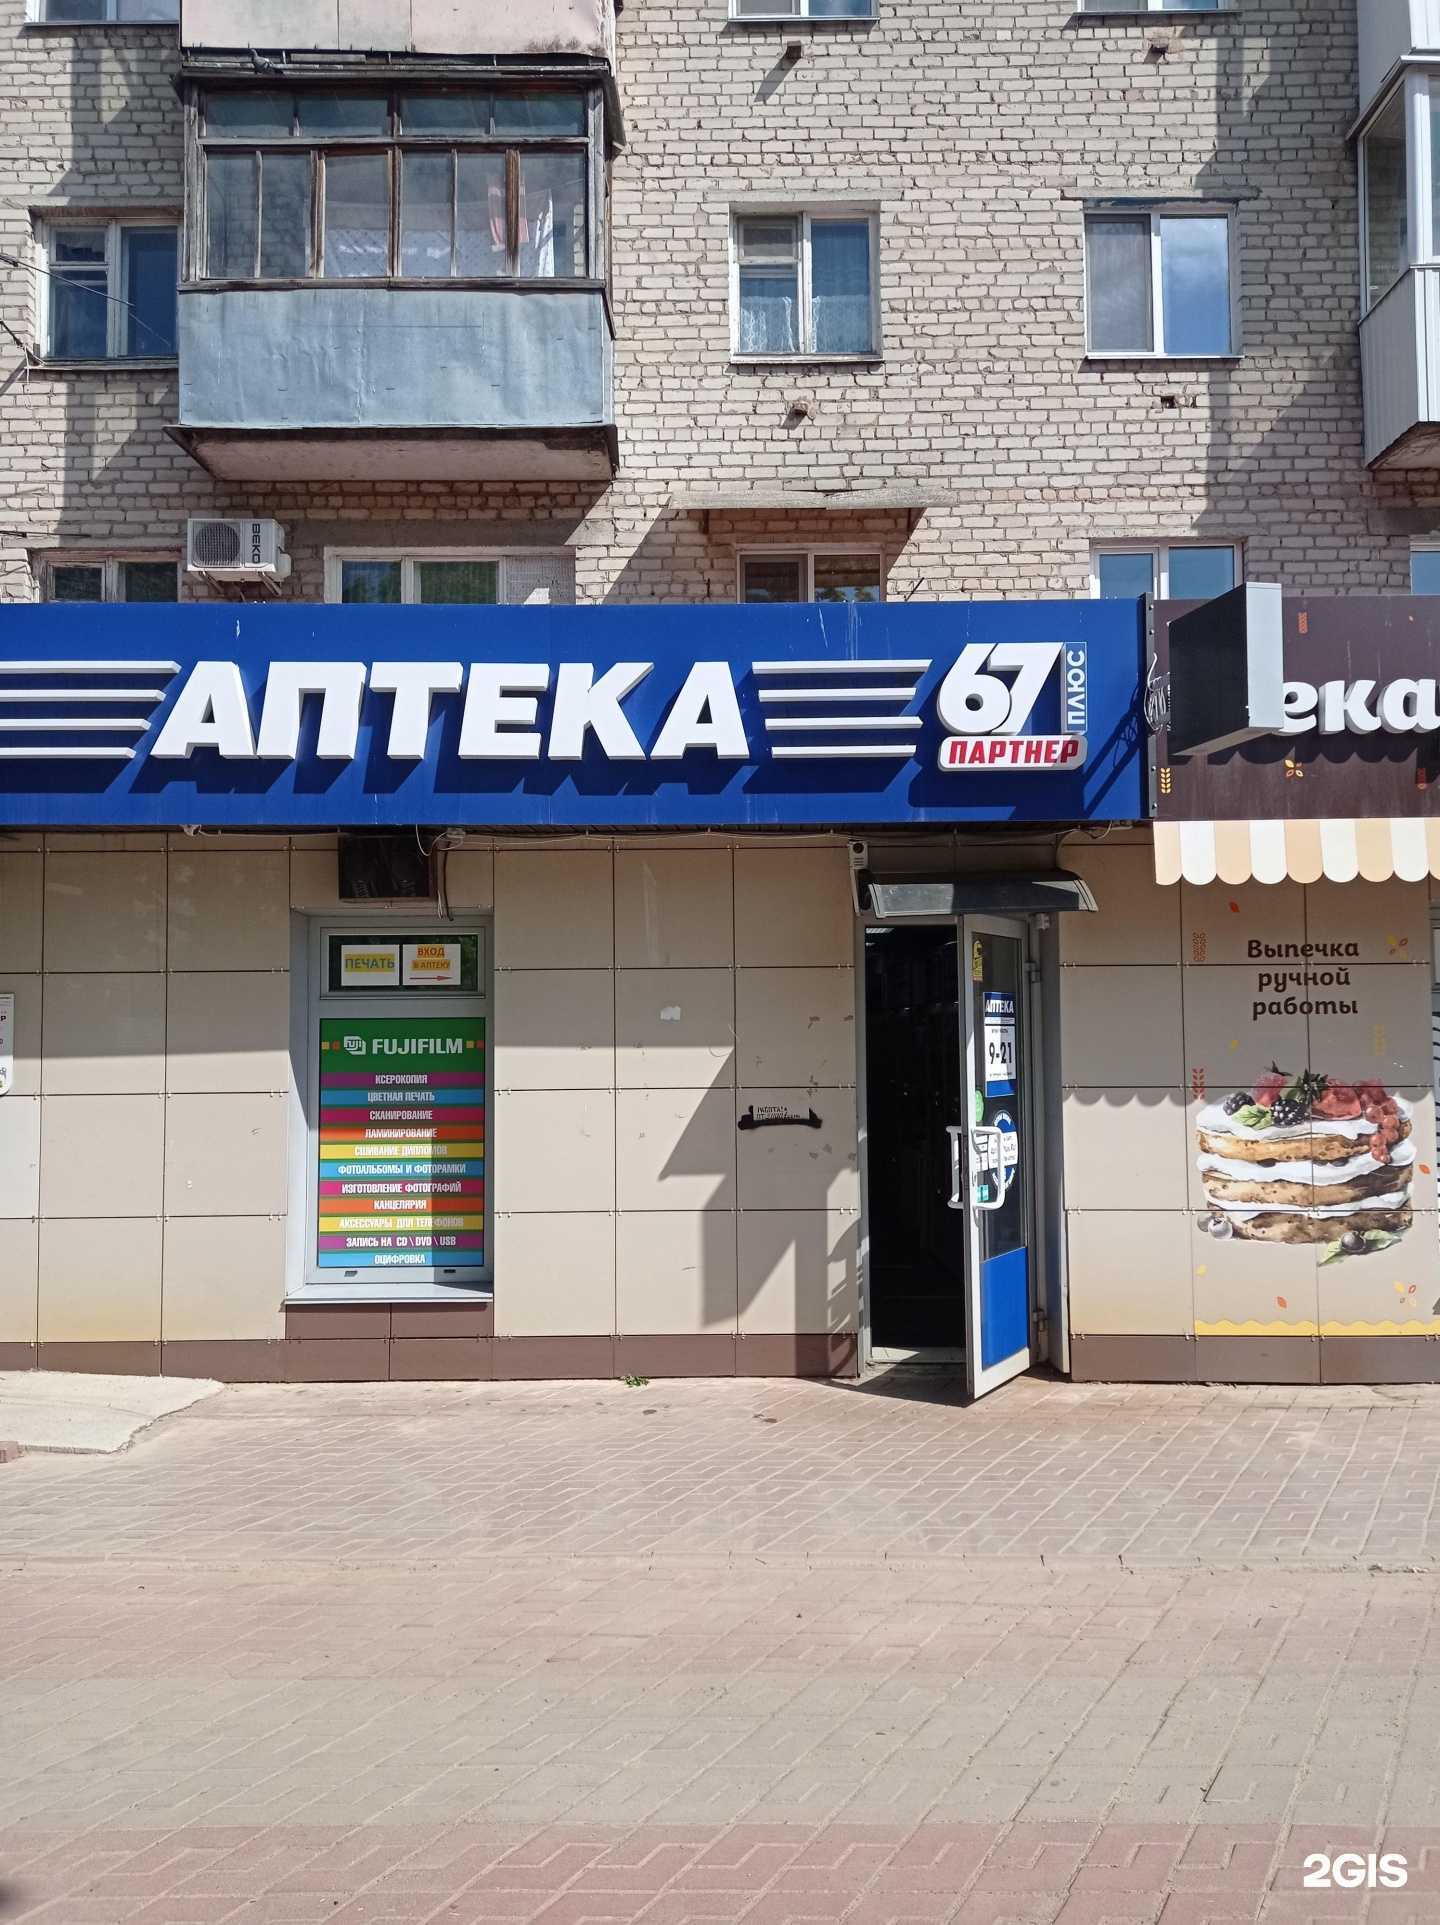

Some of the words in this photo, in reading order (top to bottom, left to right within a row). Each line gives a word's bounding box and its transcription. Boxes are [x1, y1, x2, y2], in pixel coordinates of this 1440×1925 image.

[252, 523, 261, 564] BEKO
[937, 642, 1064, 735] 67
[1067, 650, 1085, 725] ПЛЮС
[150, 660, 750, 760] АПТЕКА
[1279, 678, 1440, 735] ека
[948, 740, 1079, 764] ПАРТНЕР
[417, 947, 445, 957] ВХОД
[1247, 939, 1359, 959] Выпечка
[345, 958, 395, 969] ПЕЧАТЬ
[421, 961, 450, 969] АПТЕКУ
[1258, 967, 1351, 993] ручной
[985, 1000, 1014, 1013] АПТЕКА
[1253, 997, 1359, 1021] работы
[372, 1038, 463, 1054] FUJIFILM
[989, 1042, 1012, 1064] 9-21
[375, 1074, 428, 1084] КСЕРОКОПИЯ
[367, 1091, 403, 1102] ЦВЕТНАЯ
[405, 1091, 435, 1101] ПЕЧАТЬ
[369, 1110, 433, 1120] СКАНИРОВАНИЕ
[365, 1128, 438, 1138] ЛАМИНИРОВАНИЕ
[355, 1145, 400, 1156] СШИВАНИЕ
[402, 1145, 447, 1156] ДИПЛОМОВ
[338, 1164, 403, 1175] ФОТОАЛЬБОМЫ
[406, 1164, 412, 1173] И
[414, 1163, 466, 1174] ФОТОРАМКИ
[341, 1183, 402, 1194] ИЗГОТОВЛЕНИЕ
[405, 1181, 462, 1192] ФОТОГРАФИЙ
[373, 1200, 427, 1210] КАНЦЕЛЯРИЯ
[339, 1218, 393, 1228] АКСЕССУАРЫ
[416, 1217, 464, 1228] ТЕЛЕФОНОВ
[346, 1236, 379, 1247] ЗАПИСЬ
[381, 1236, 392, 1246] НА
[396, 1236, 408, 1246] CD
[415, 1236, 432, 1246] DVD
[440, 1236, 456, 1246] USB
[374, 1254, 426, 1265] ОЦИФРОВКА
